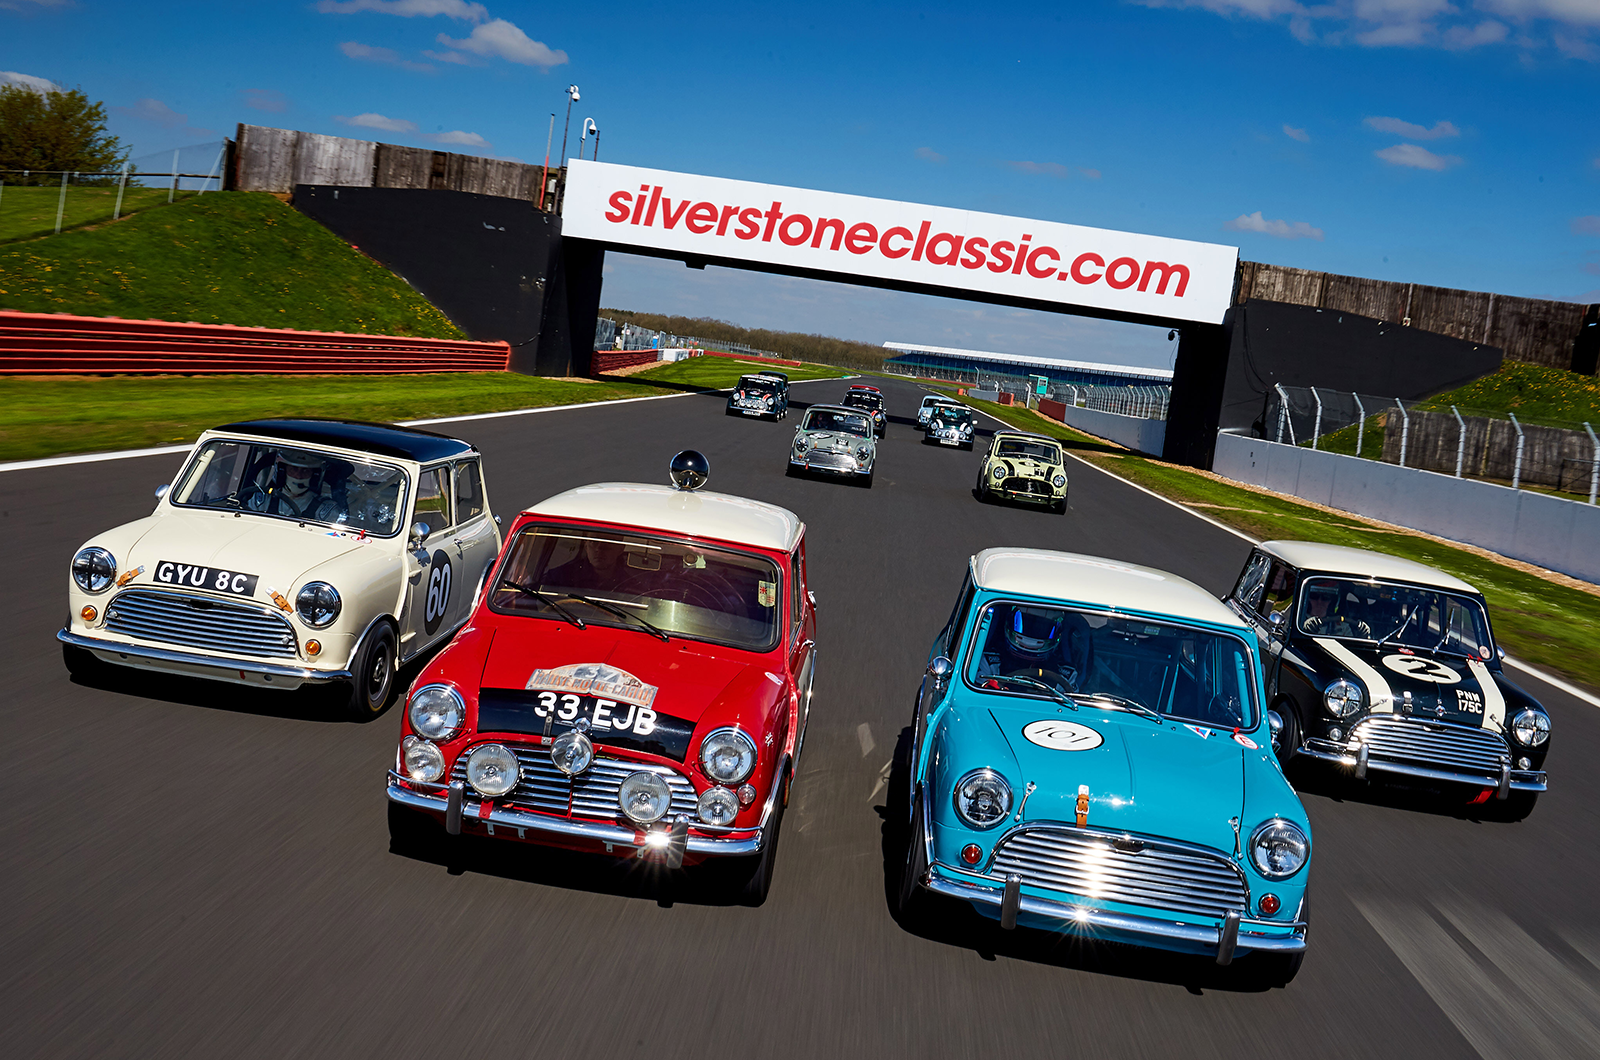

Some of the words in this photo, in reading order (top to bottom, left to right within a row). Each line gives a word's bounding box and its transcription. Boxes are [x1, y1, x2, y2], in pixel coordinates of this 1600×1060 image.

[605, 184, 1190, 298] silverstoneclassic.com
[158, 563, 208, 586] GYU
[215, 571, 248, 593] 8C
[426, 563, 451, 622] 60
[1398, 658, 1452, 680] 2
[534, 691, 581, 720] 33
[591, 699, 657, 735] EJB
[1458, 699, 1482, 714] 175C
[1034, 726, 1092, 743] 101
